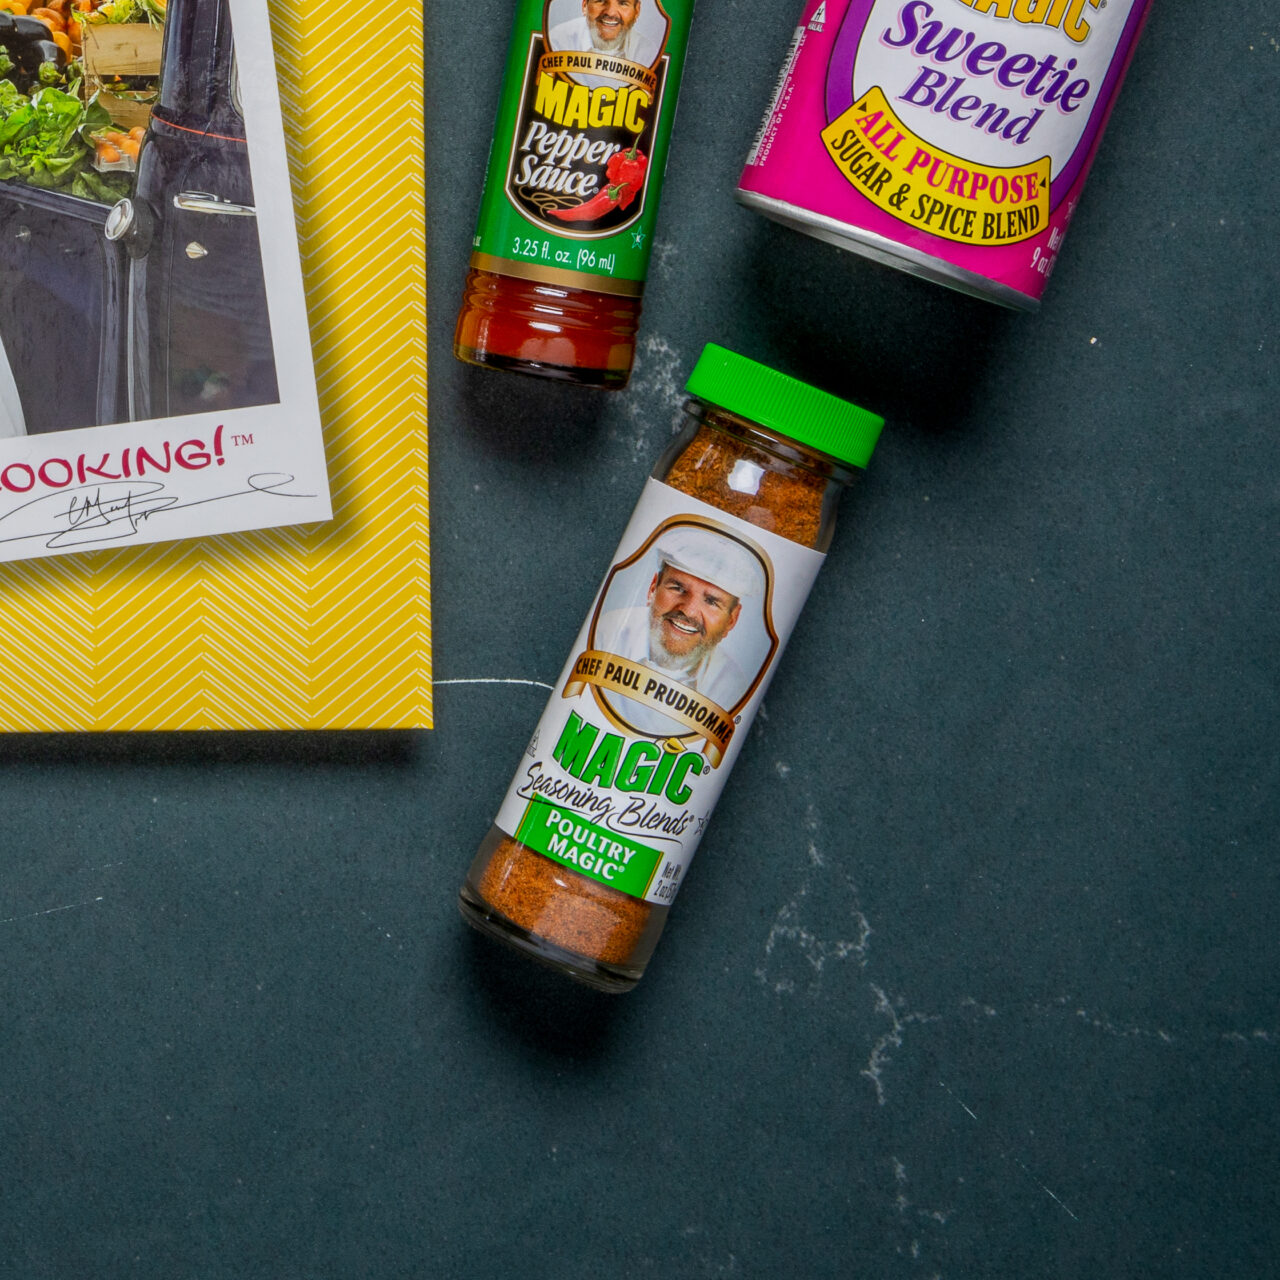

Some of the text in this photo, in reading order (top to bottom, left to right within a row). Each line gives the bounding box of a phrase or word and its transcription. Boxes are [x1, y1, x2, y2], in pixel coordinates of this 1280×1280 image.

[542, 55, 656, 89] CHEF PAUL PRUDHOMME
[880, 0, 1090, 114] Sweetie
[534, 70, 649, 134] MAGIC
[759, 84, 796, 167] PRODUCT OF U.S.A.
[896, 65, 1045, 145] Blend
[521, 121, 621, 168] Pepper
[855, 109, 1040, 205] ALL PURPOSE
[831, 128, 1040, 240] SUGAR & SPICE BLEND
[512, 237, 539, 257] 3.25
[541, 241, 551, 260] fl.
[555, 251, 572, 264] oz.
[576, 248, 596, 269] (96
[1030, 247, 1041, 268] 9
[576, 657, 733, 744] CHEF PAUL PRUDHOMME
[520, 761, 615, 825] Seasoning
[545, 809, 637, 865] POULTRY
